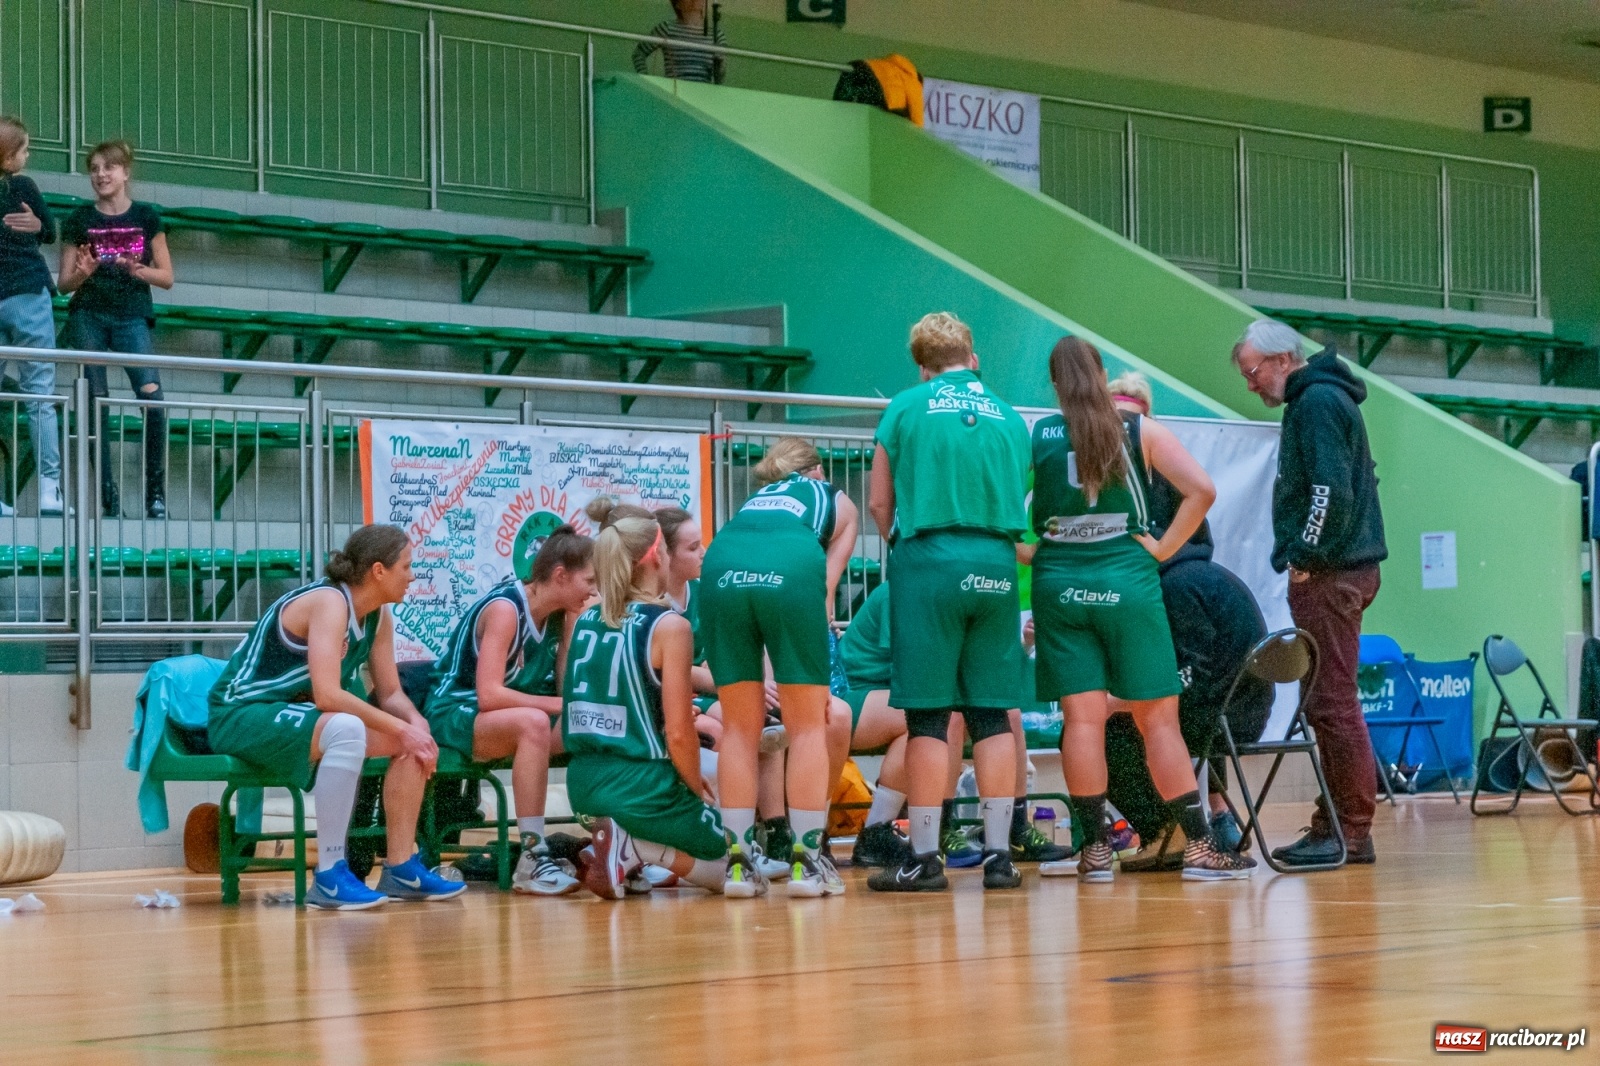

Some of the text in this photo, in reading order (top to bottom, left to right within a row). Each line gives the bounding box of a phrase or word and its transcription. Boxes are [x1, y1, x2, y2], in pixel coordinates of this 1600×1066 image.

[1493, 108, 1524, 129] D
[928, 399, 1002, 416] BASKETBALL
[1042, 426, 1064, 439] RKK
[389, 435, 473, 459] MarzenaN
[495, 487, 536, 557] GRAMY
[540, 485, 568, 518] DLA
[410, 558, 448, 569] artoszK
[733, 570, 784, 585] Clavis
[974, 575, 1012, 591] Clavis
[1073, 589, 1120, 603] Clavis
[573, 629, 625, 697] 27
[1420, 674, 1471, 698] molten
